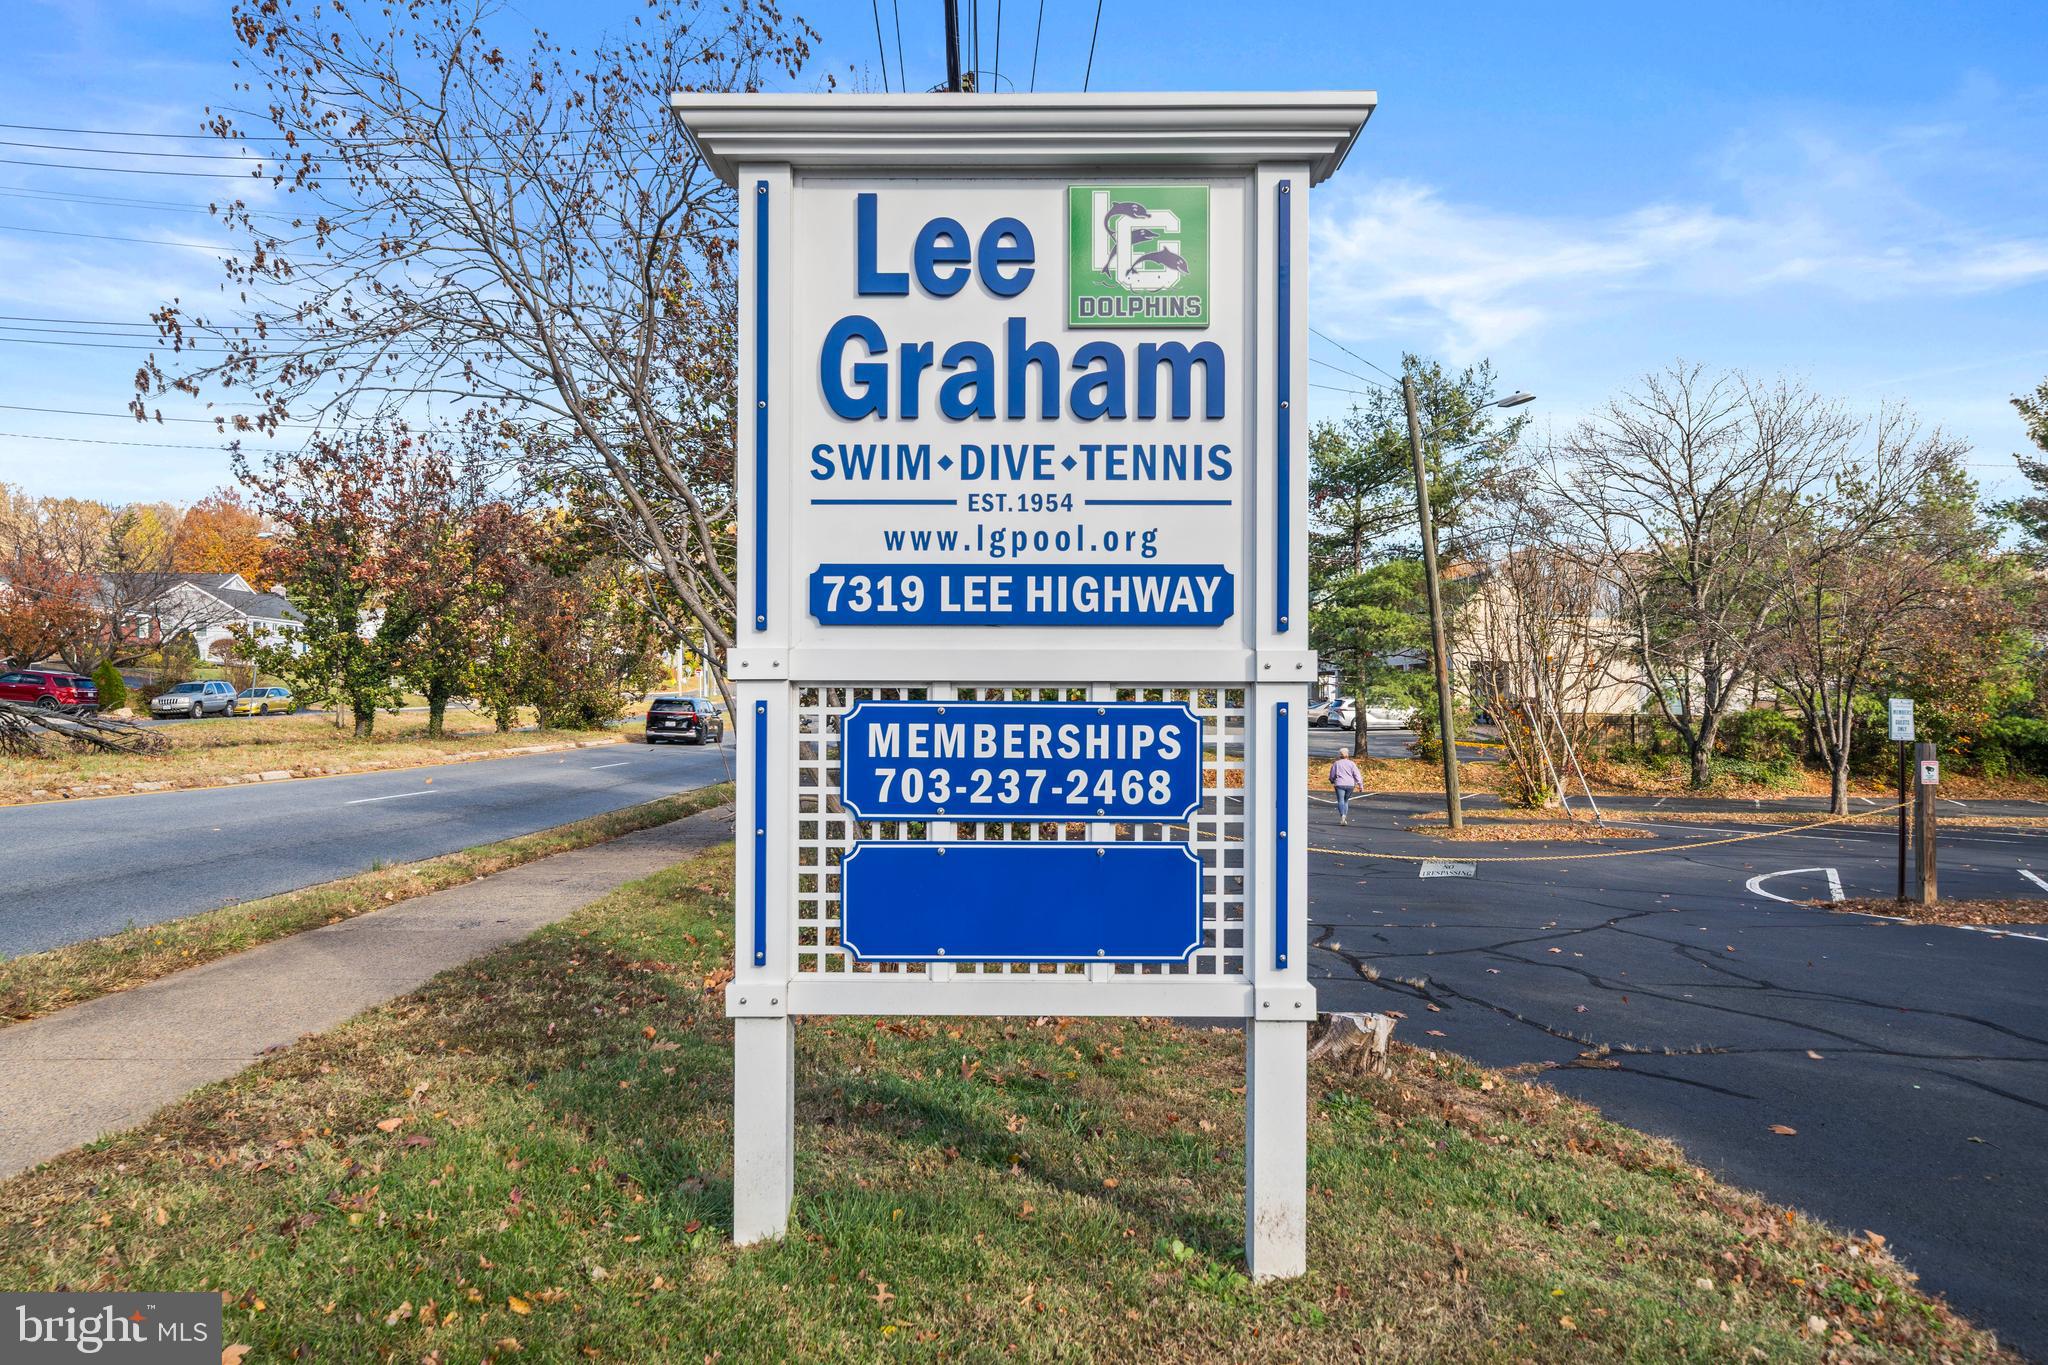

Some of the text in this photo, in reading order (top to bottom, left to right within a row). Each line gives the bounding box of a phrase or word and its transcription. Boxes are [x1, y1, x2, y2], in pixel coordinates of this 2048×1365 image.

[857, 193, 1035, 298] Lee
[1079, 296, 1201, 317] DOLPHINS
[820, 315, 1226, 420] Graham
[810, 443, 1233, 481] SWIM DIVE TENNIS
[884, 524, 1158, 558] www.lgpool.org
[822, 575, 1222, 613] 7319 LEE HIGHWAY
[868, 722, 1182, 760] MEMBERSHIPS
[874, 768, 1172, 805] 703-237-2468
